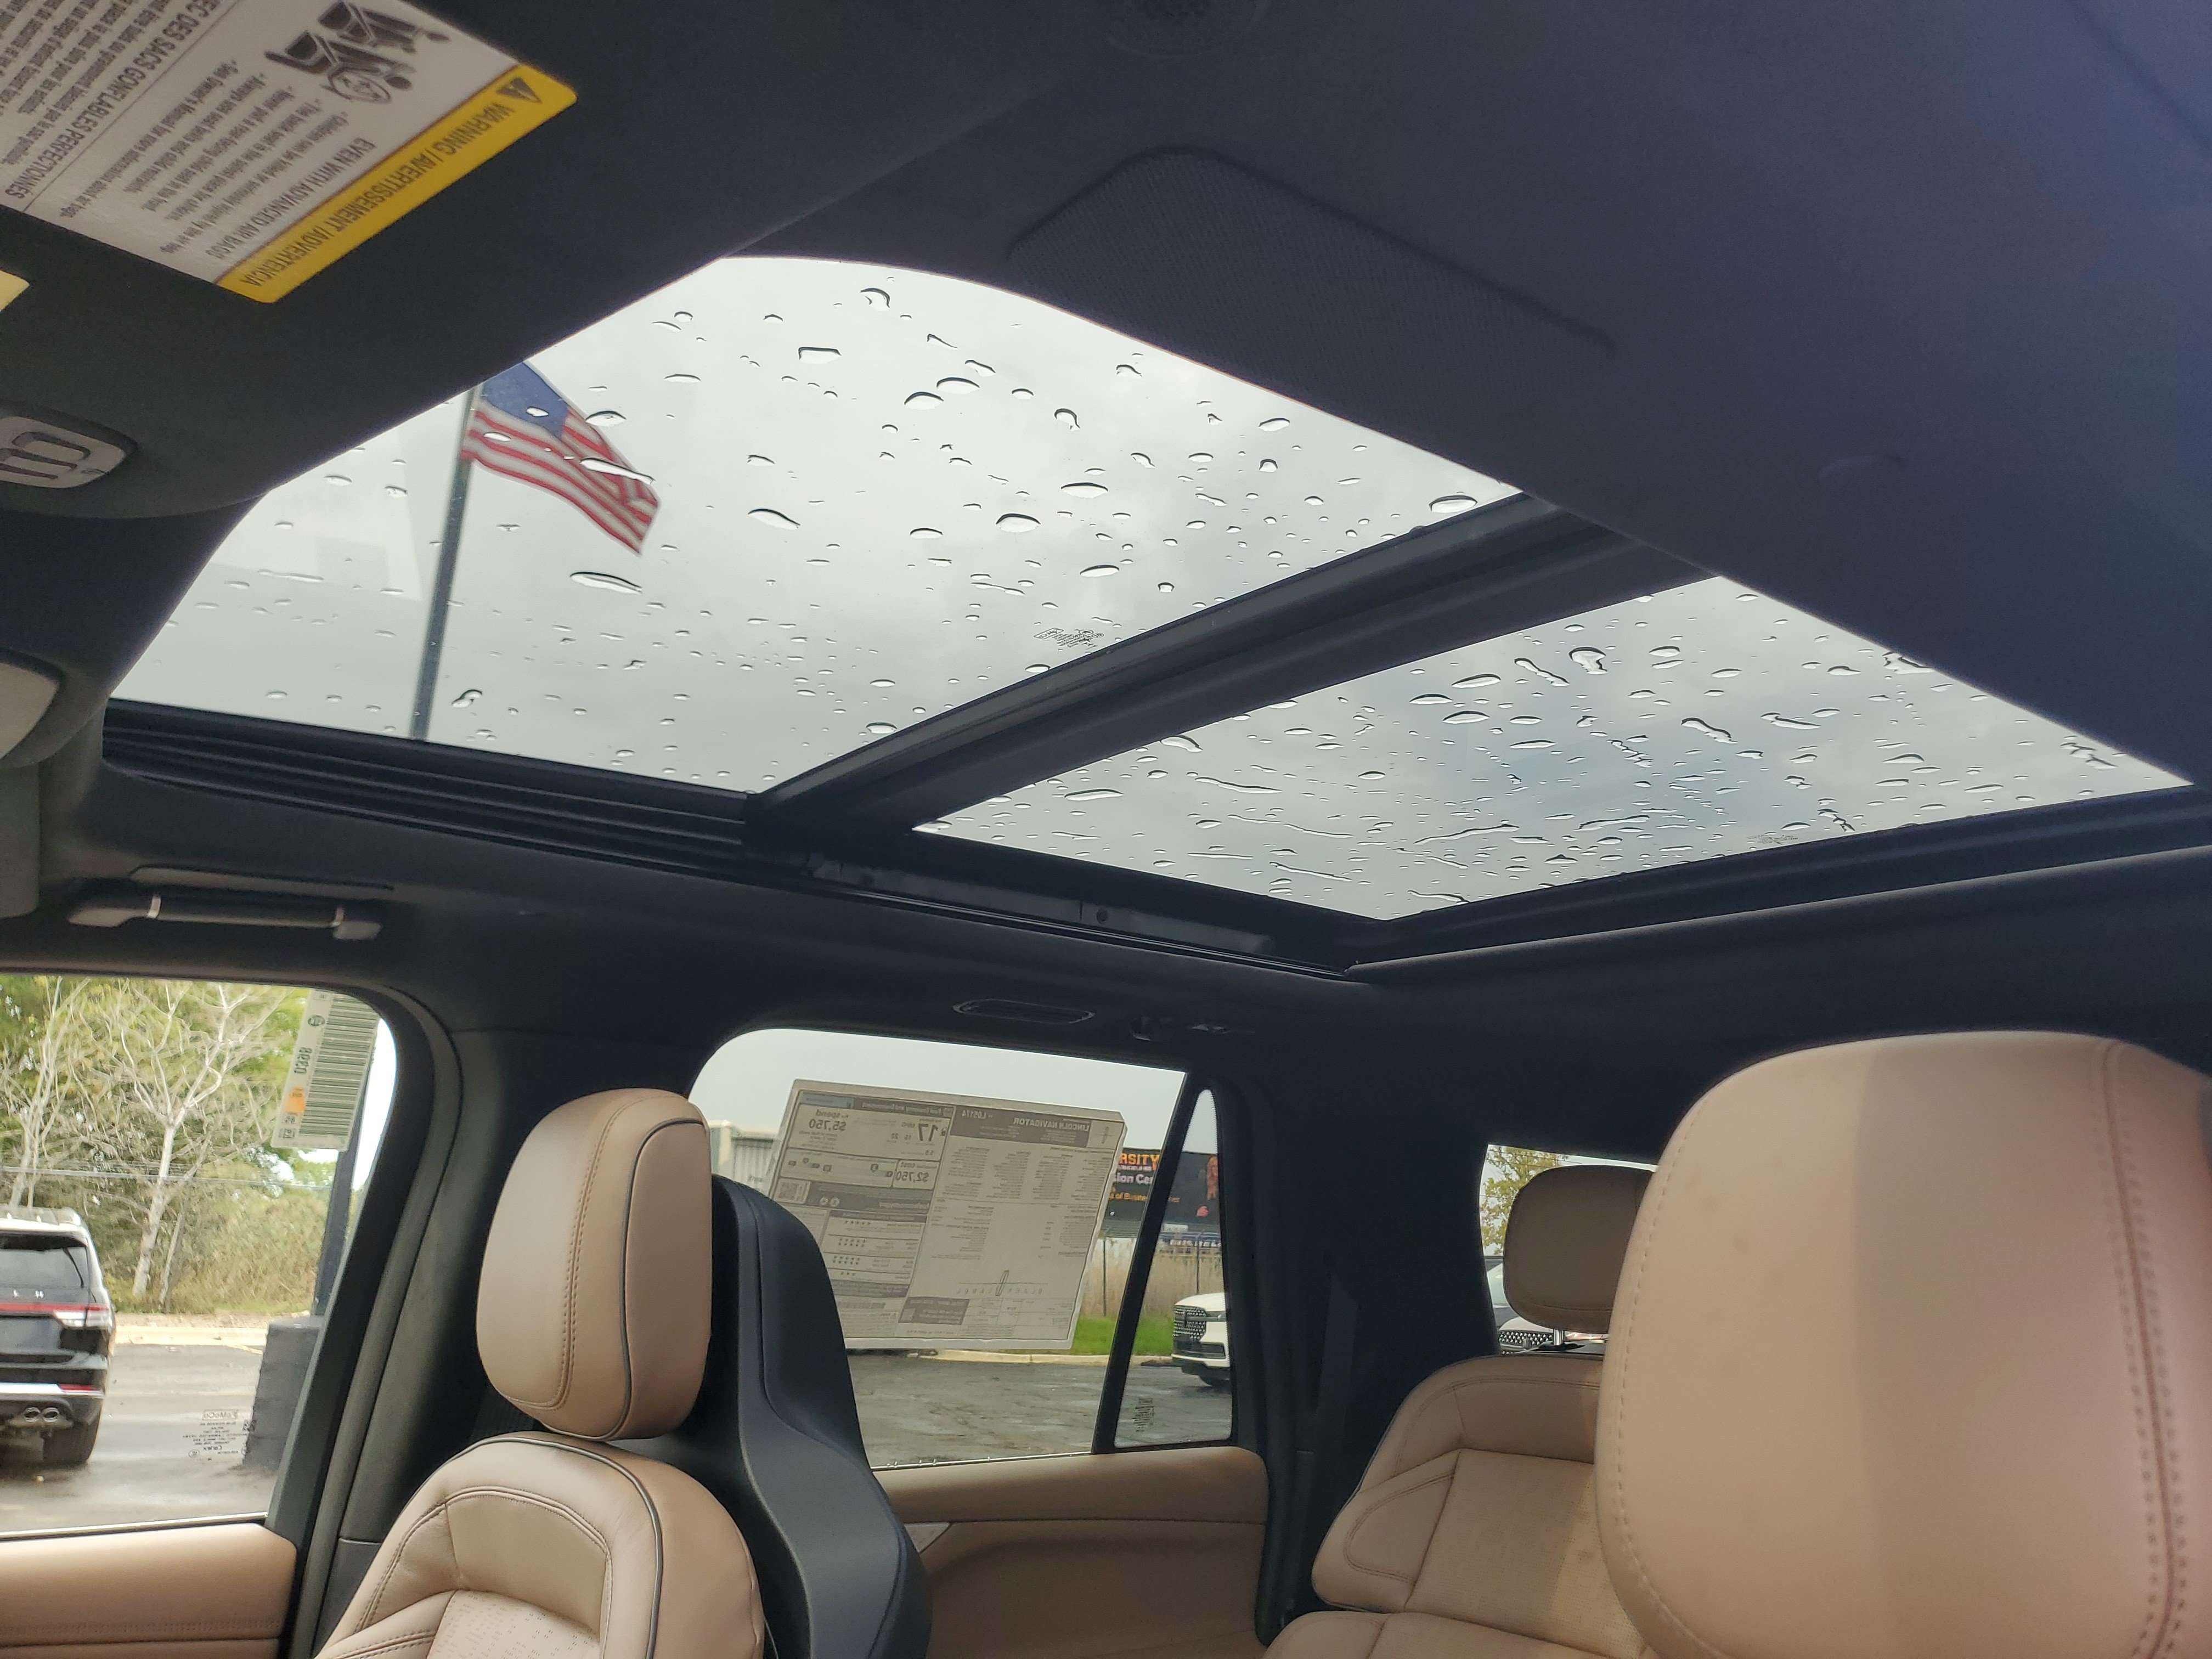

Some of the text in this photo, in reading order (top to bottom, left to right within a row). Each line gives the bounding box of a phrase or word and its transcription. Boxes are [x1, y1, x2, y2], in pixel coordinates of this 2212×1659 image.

[162, 13, 200, 41] DES
[133, 37, 176, 70] SACS
[71, 67, 146, 132] GONFLABLES
[432, 102, 514, 155] WARNING
[5, 128, 85, 199] PERFECTIONNÉS
[332, 138, 376, 166] EVEN
[305, 162, 344, 187] WITH
[250, 182, 314, 225] ADVANCED
[233, 223, 259, 239] AIR
